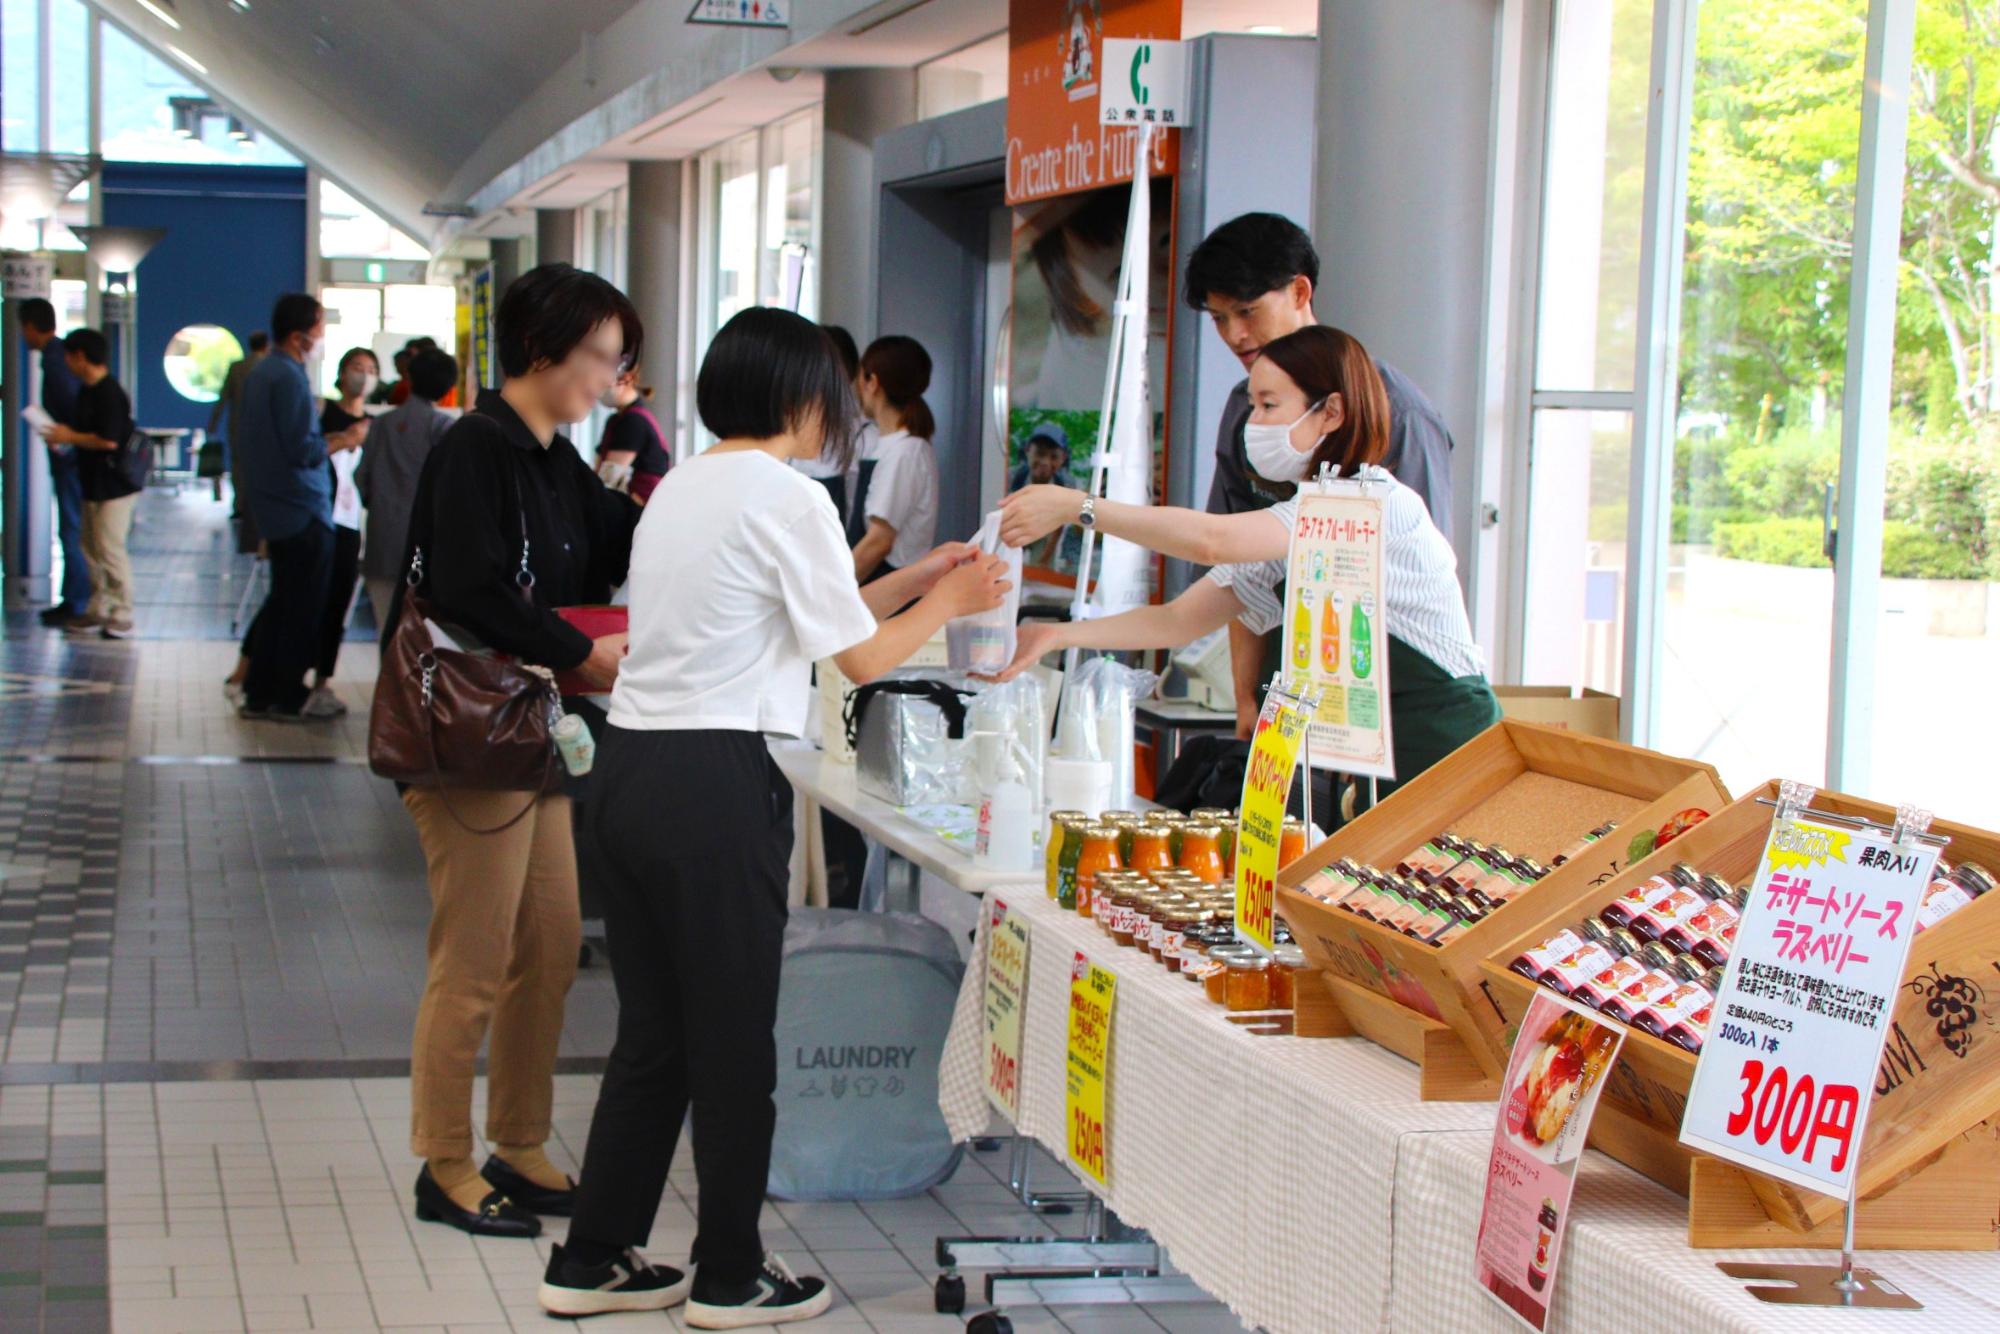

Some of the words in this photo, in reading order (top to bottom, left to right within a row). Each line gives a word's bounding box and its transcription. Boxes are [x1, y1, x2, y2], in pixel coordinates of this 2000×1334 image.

[1106, 107, 1174, 122] 公衆電話
[1006, 137, 1061, 199] Create
[1065, 123, 1093, 189] the
[1858, 846, 1919, 876] 果肉入り
[1243, 867, 1273, 941] 250円
[1766, 873, 1904, 941] デザートソース
[1771, 919, 1870, 974] ラズベリー
[1719, 1022, 1757, 1049] 300g入
[1726, 1003, 1794, 1034] 定価640円のところ
[796, 1045, 917, 1069] LAUNDRY
[1074, 1105, 1104, 1177] 250円
[1726, 1060, 1860, 1172] 300円
